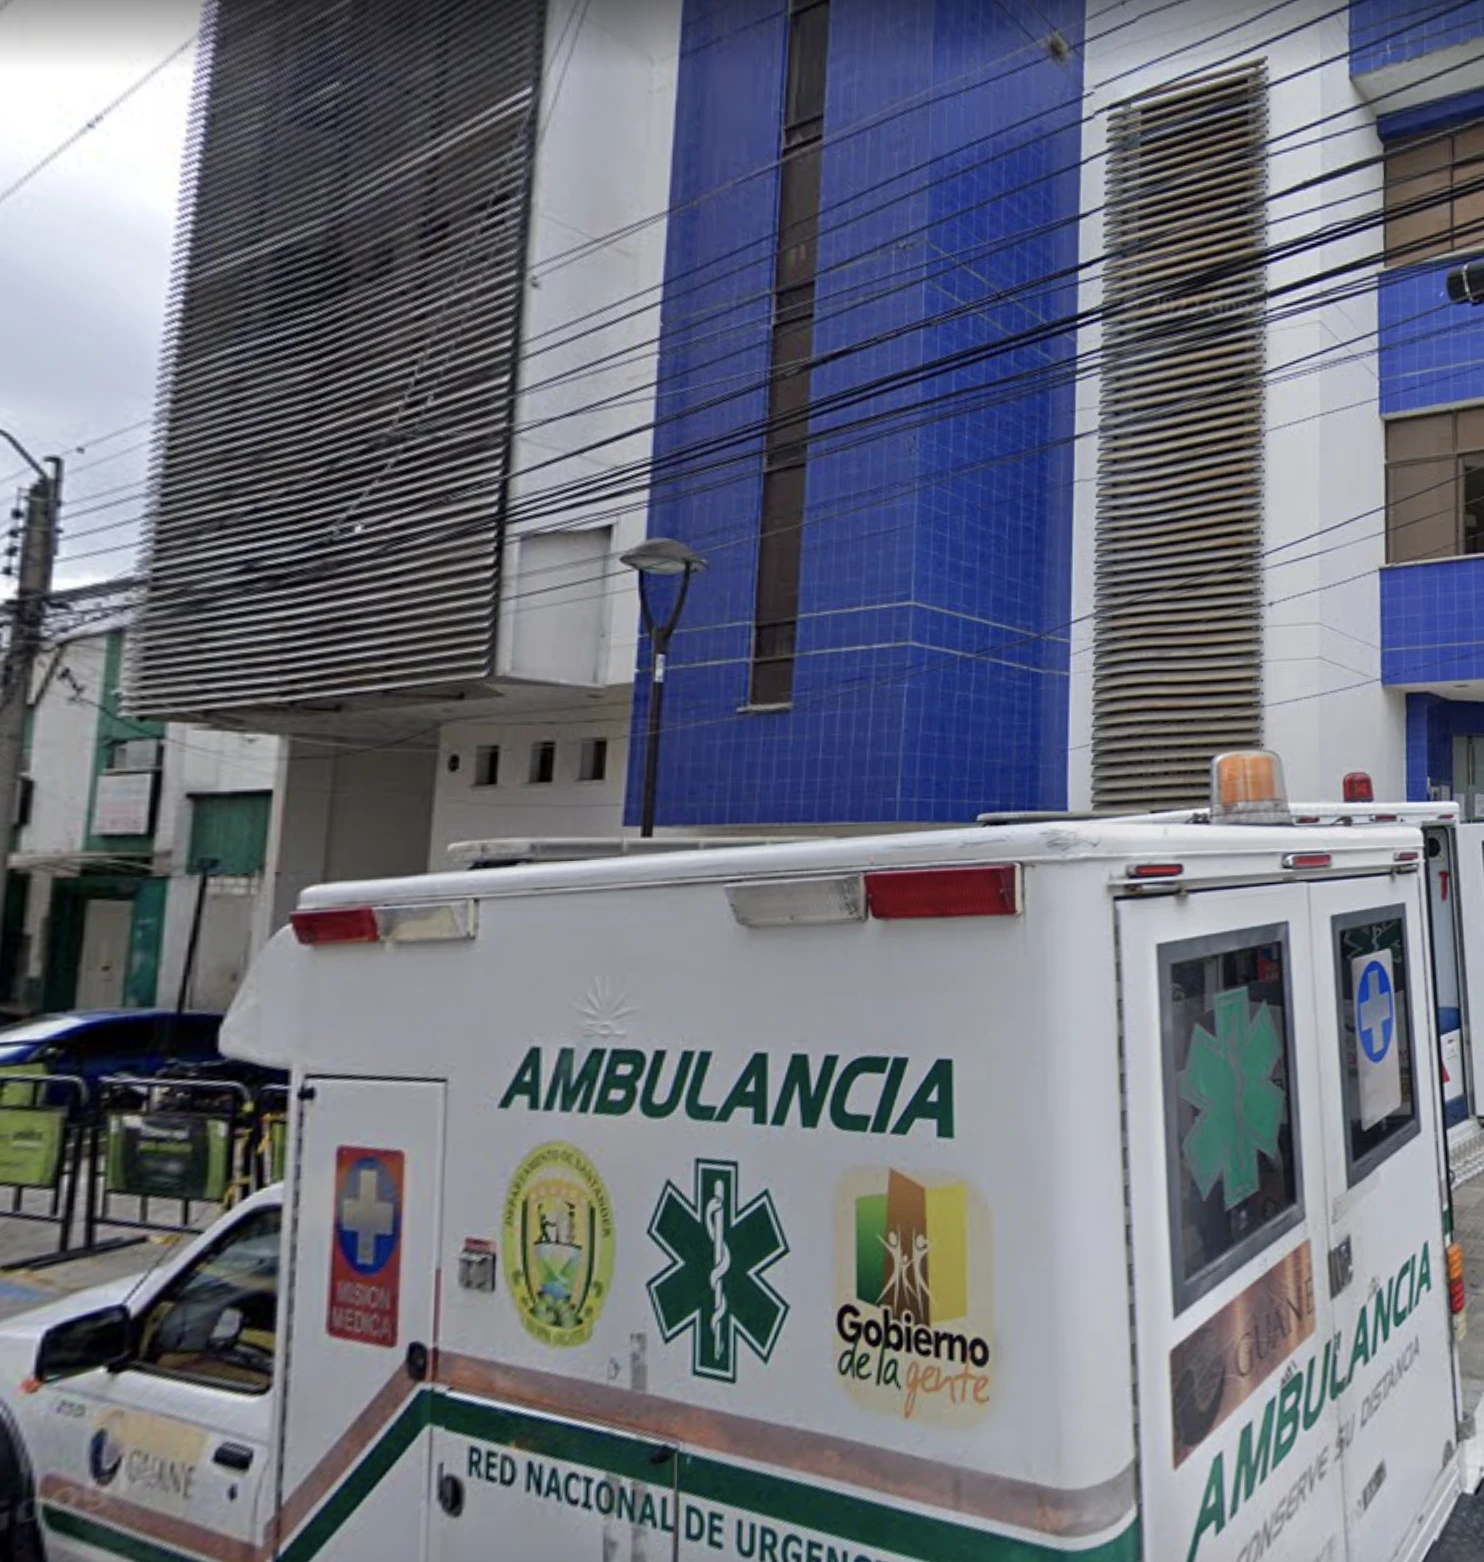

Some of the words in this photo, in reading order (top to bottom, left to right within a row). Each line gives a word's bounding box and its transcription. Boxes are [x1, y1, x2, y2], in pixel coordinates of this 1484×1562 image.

[499, 1047, 954, 1139] AMBULANCIA
[836, 1303, 989, 1368] Gobierno
[1237, 1275, 1316, 1377] GUANE
[838, 1338, 872, 1380] de
[875, 1340, 902, 1390] la
[904, 1352, 990, 1419] gente
[1187, 1240, 1432, 1562] AMBULANCIA
[1361, 1334, 1420, 1428] DISTANCIA
[468, 1446, 517, 1486] RED
[525, 1460, 674, 1533] NACIONAL
[684, 1505, 724, 1548] DE
